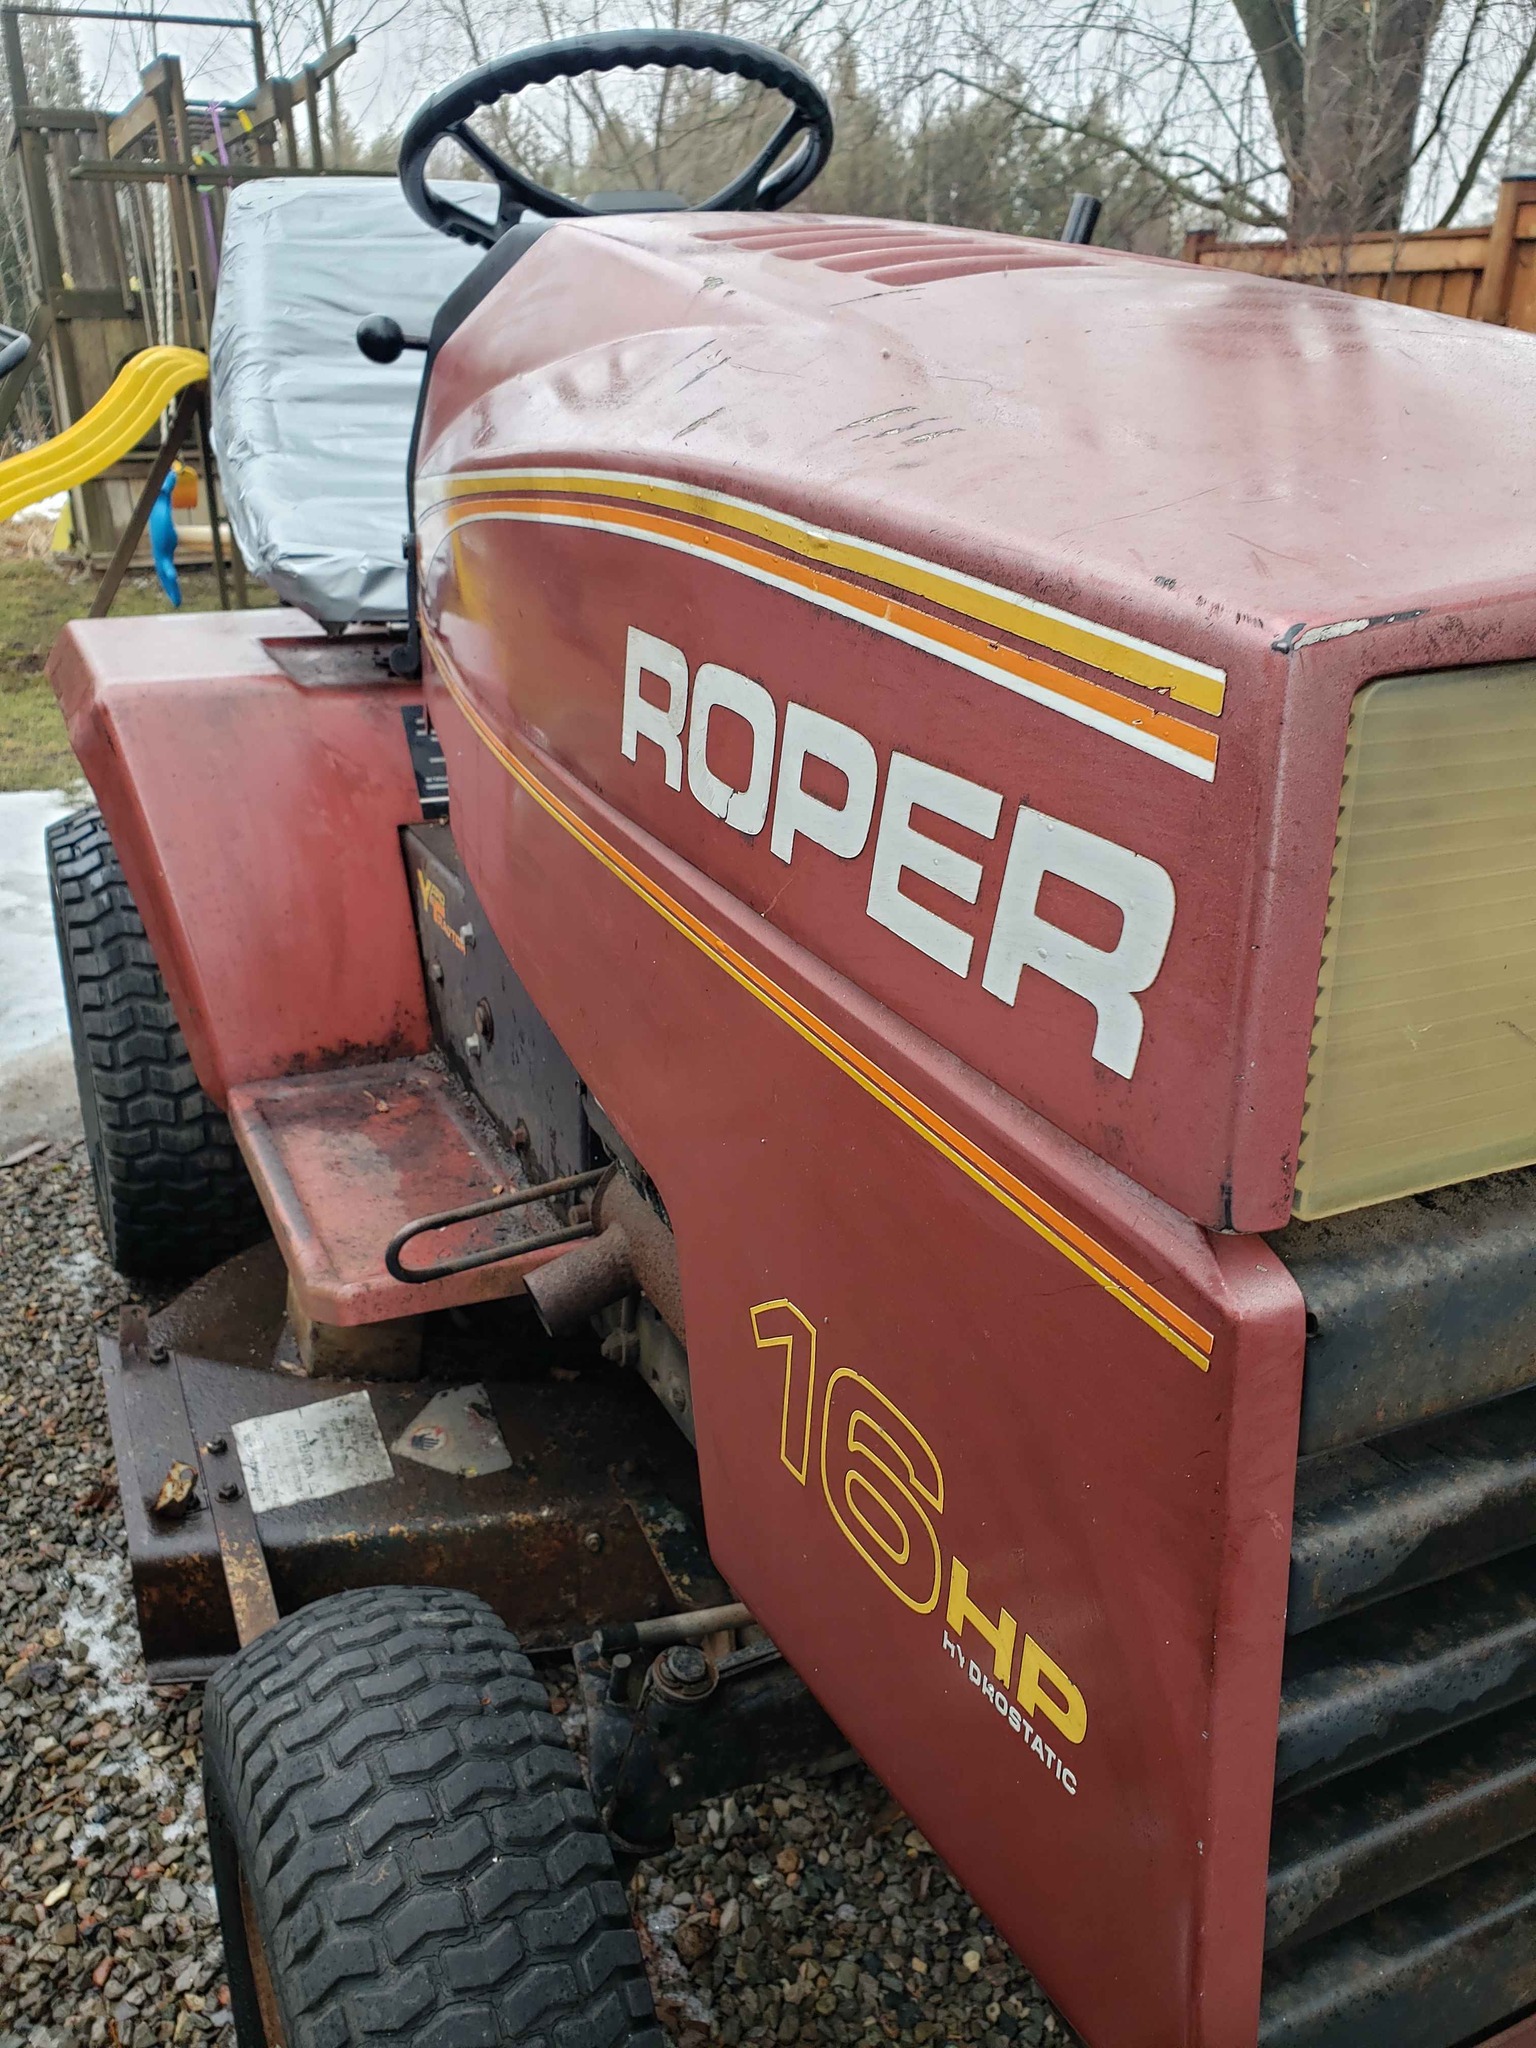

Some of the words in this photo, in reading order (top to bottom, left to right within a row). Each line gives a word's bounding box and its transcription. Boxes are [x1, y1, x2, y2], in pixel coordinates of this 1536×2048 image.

[621, 626, 1176, 1080] ROPER
[750, 1298, 945, 1614] 16
[946, 1556, 1088, 1744] HP
[942, 1630, 1077, 1796] HYDROSTATIC
